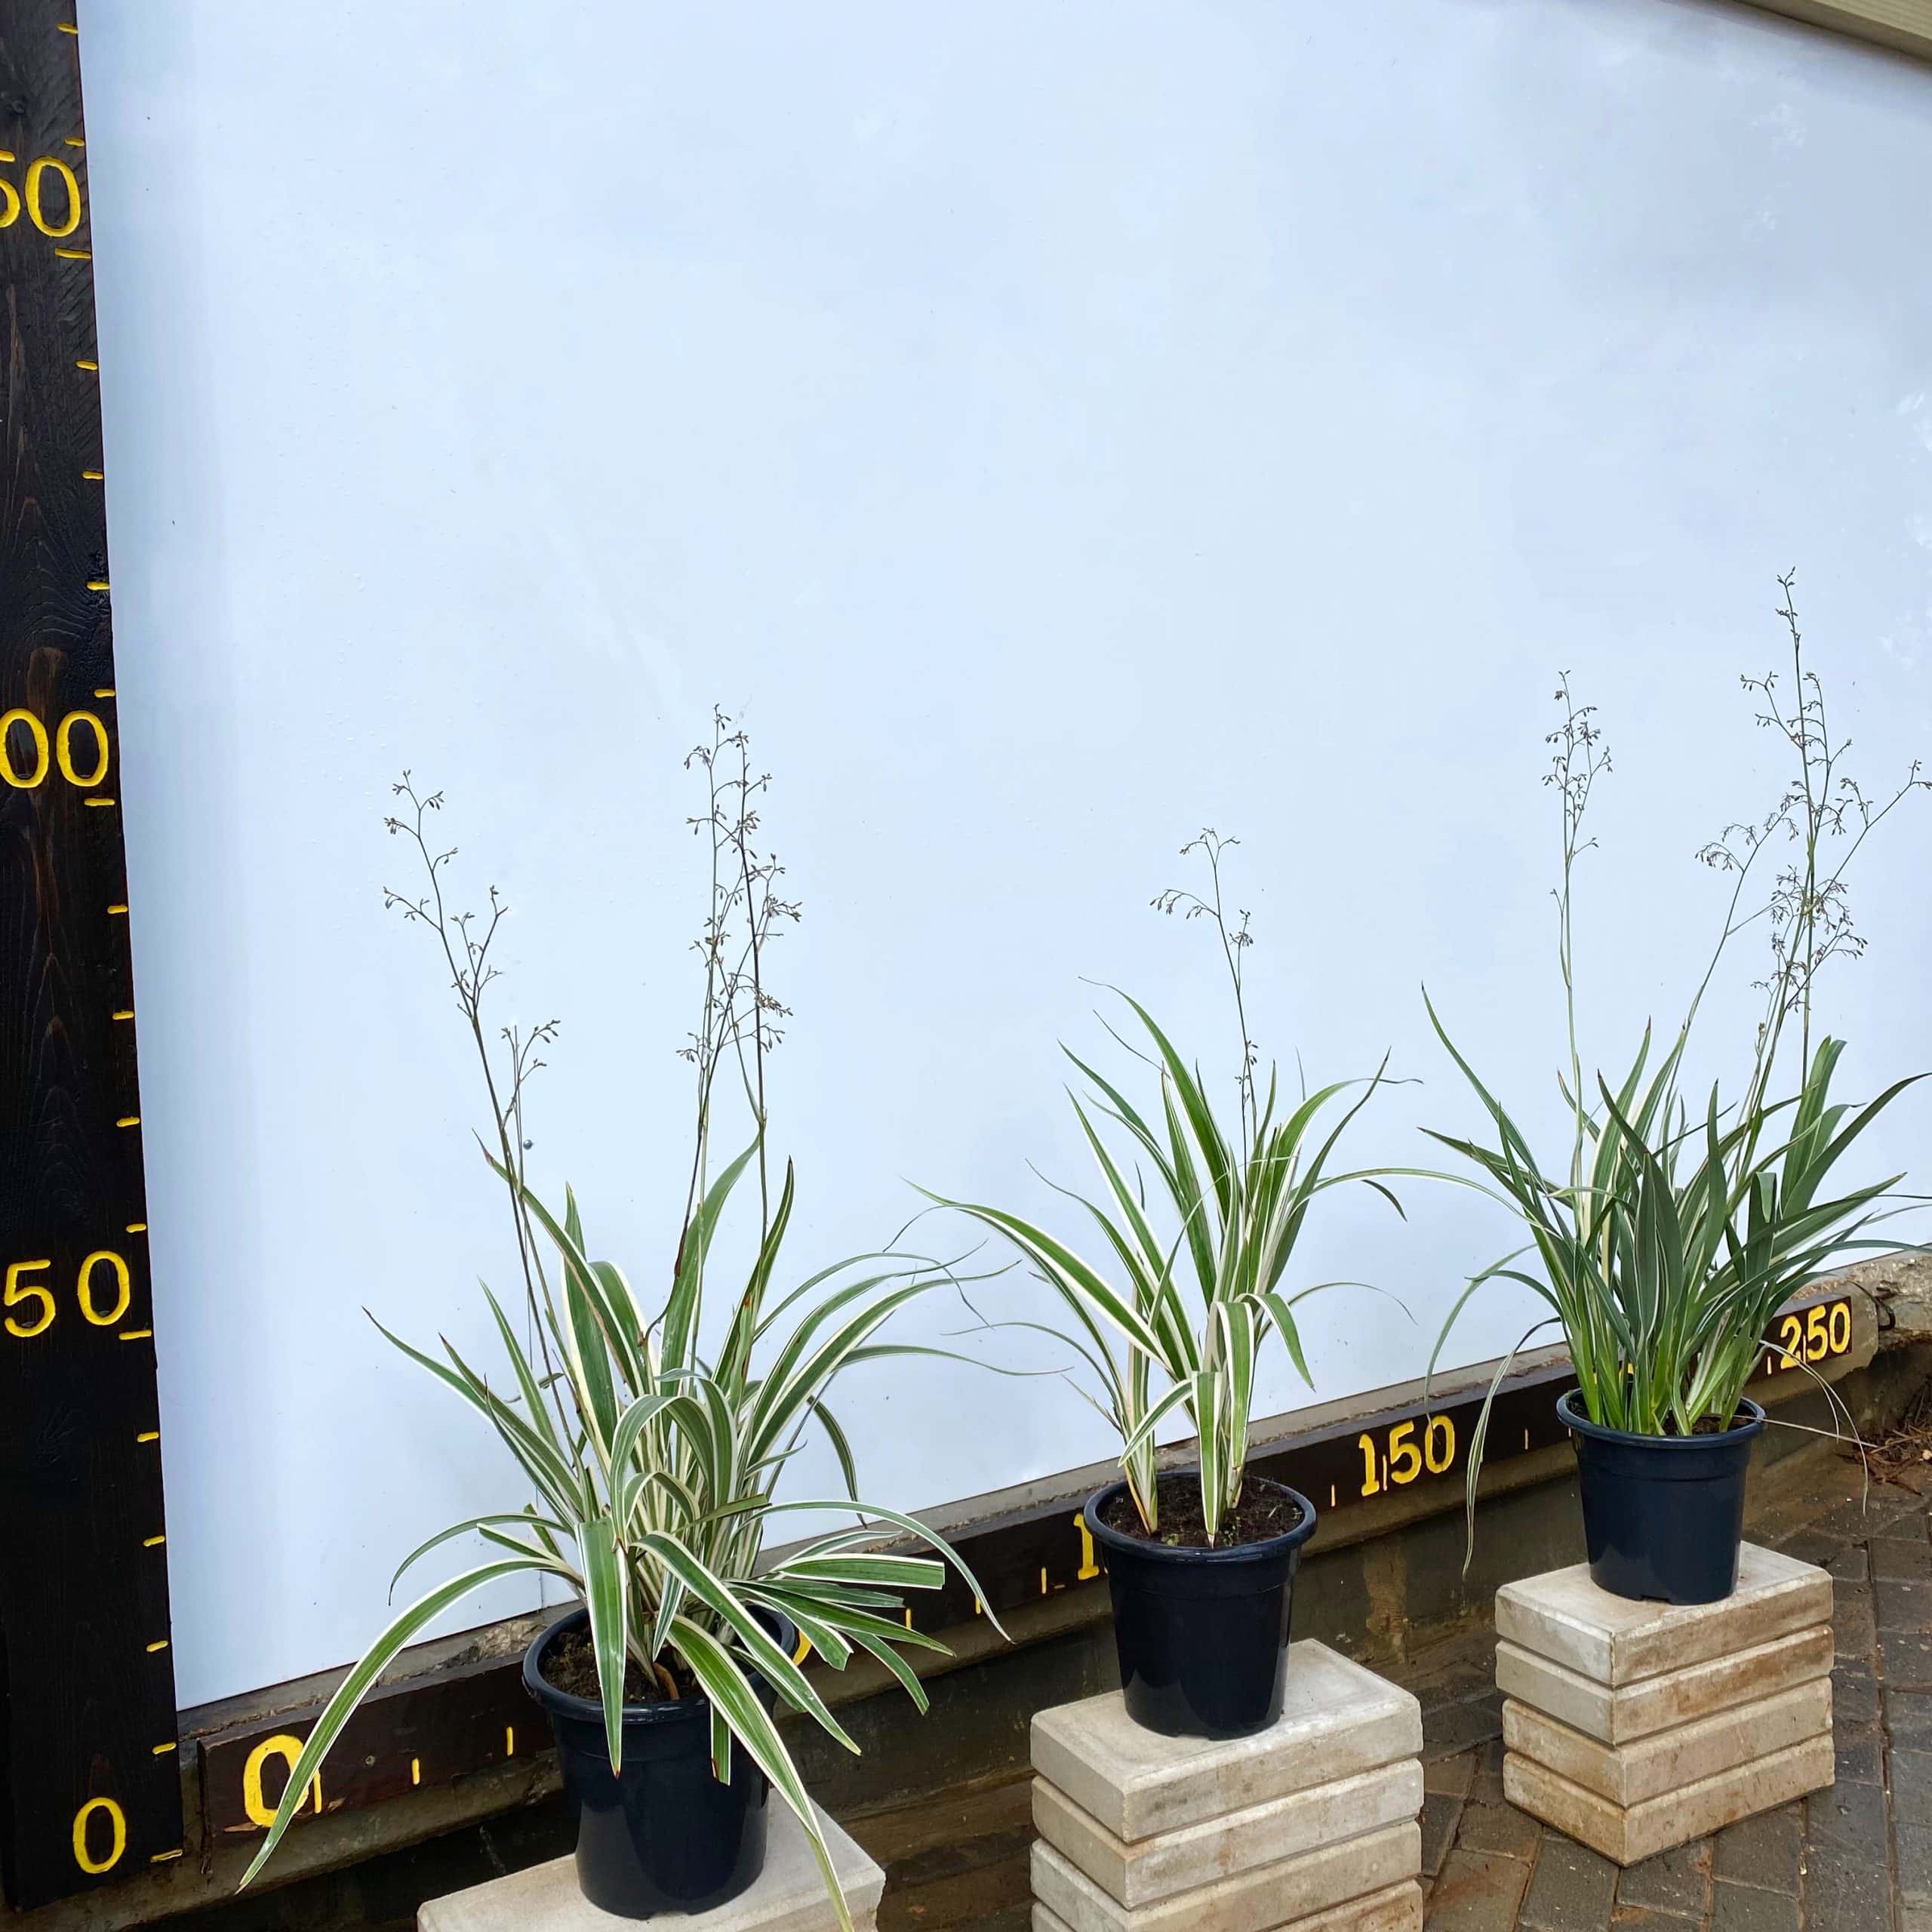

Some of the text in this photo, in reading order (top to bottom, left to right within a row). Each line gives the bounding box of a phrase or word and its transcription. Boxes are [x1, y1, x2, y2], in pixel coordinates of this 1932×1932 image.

[4, 1251, 131, 1338] 50
[1780, 1302, 1851, 1370] 250
[1358, 1415, 1456, 1497] 150
[72, 1797, 126, 1874] 0
